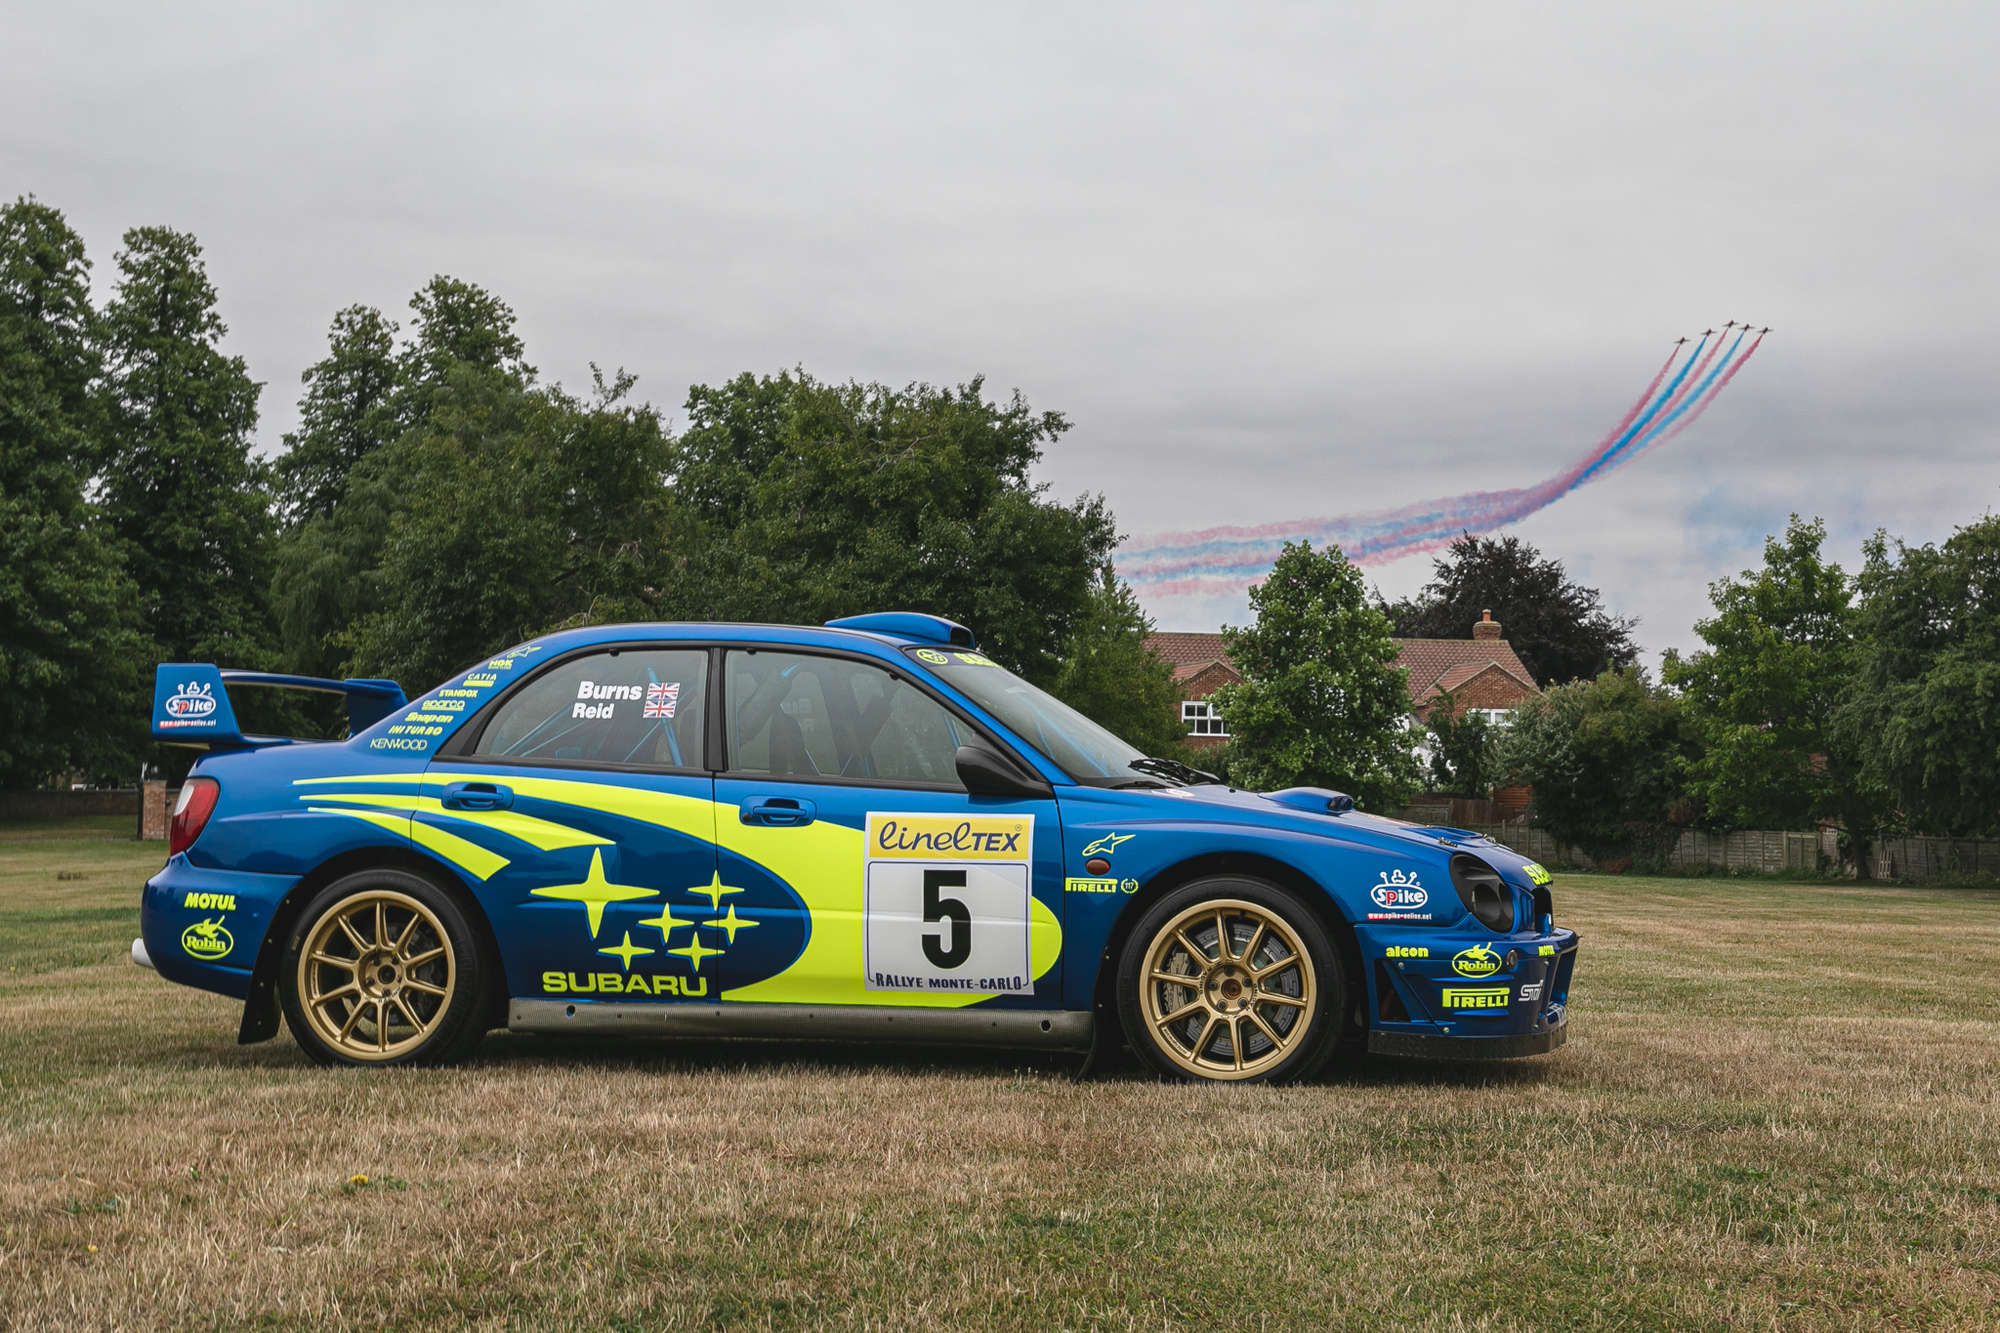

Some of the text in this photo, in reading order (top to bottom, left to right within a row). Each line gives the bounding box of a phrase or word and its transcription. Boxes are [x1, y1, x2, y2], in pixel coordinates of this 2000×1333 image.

[467, 673, 497, 681] CATIA
[438, 689, 478, 698] STANDOX
[577, 680, 643, 700] Burns
[170, 699, 213, 715] Spike
[572, 702, 615, 719] Reid
[404, 725, 443, 736] TURBO
[369, 738, 428, 750] KENWOOD
[1065, 877, 1118, 894] PIRELLI
[184, 892, 237, 911] MOTUL
[1376, 888, 1424, 906] Spike
[921, 869, 972, 970] 5
[186, 935, 226, 952] Robin
[1385, 945, 1429, 958] alcon
[1457, 960, 1496, 972] Robin
[542, 971, 708, 997] SUBARU
[875, 972, 1022, 991] RALLYE MONTE-CARLO
[1442, 987, 1511, 1008] PIRELLI
